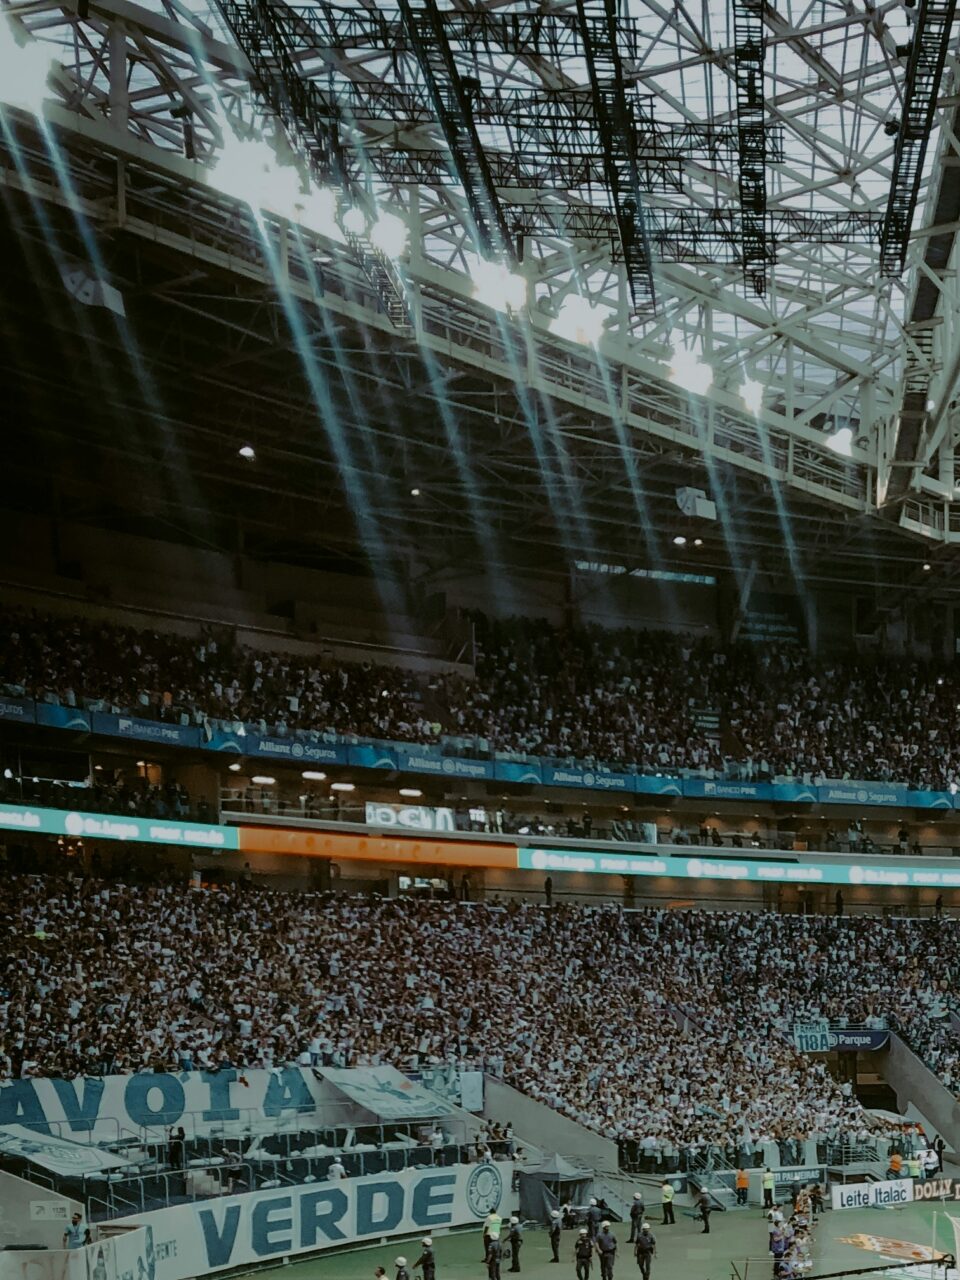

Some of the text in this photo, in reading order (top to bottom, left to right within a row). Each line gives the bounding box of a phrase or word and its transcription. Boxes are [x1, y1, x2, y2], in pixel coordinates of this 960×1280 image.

[259, 741, 337, 759] Allianz Seguros
[408, 756, 442, 769] Allianz
[553, 771, 625, 788] Allianz Seguros
[740, 787, 757, 796] PINE
[828, 790, 897, 804] Allianz Seguros
[839, 1034, 872, 1046] Parque
[840, 1186, 907, 1208] Leite Italac
[915, 1179, 953, 1200] DOLLY
[199, 1174, 457, 1267] VERDE
